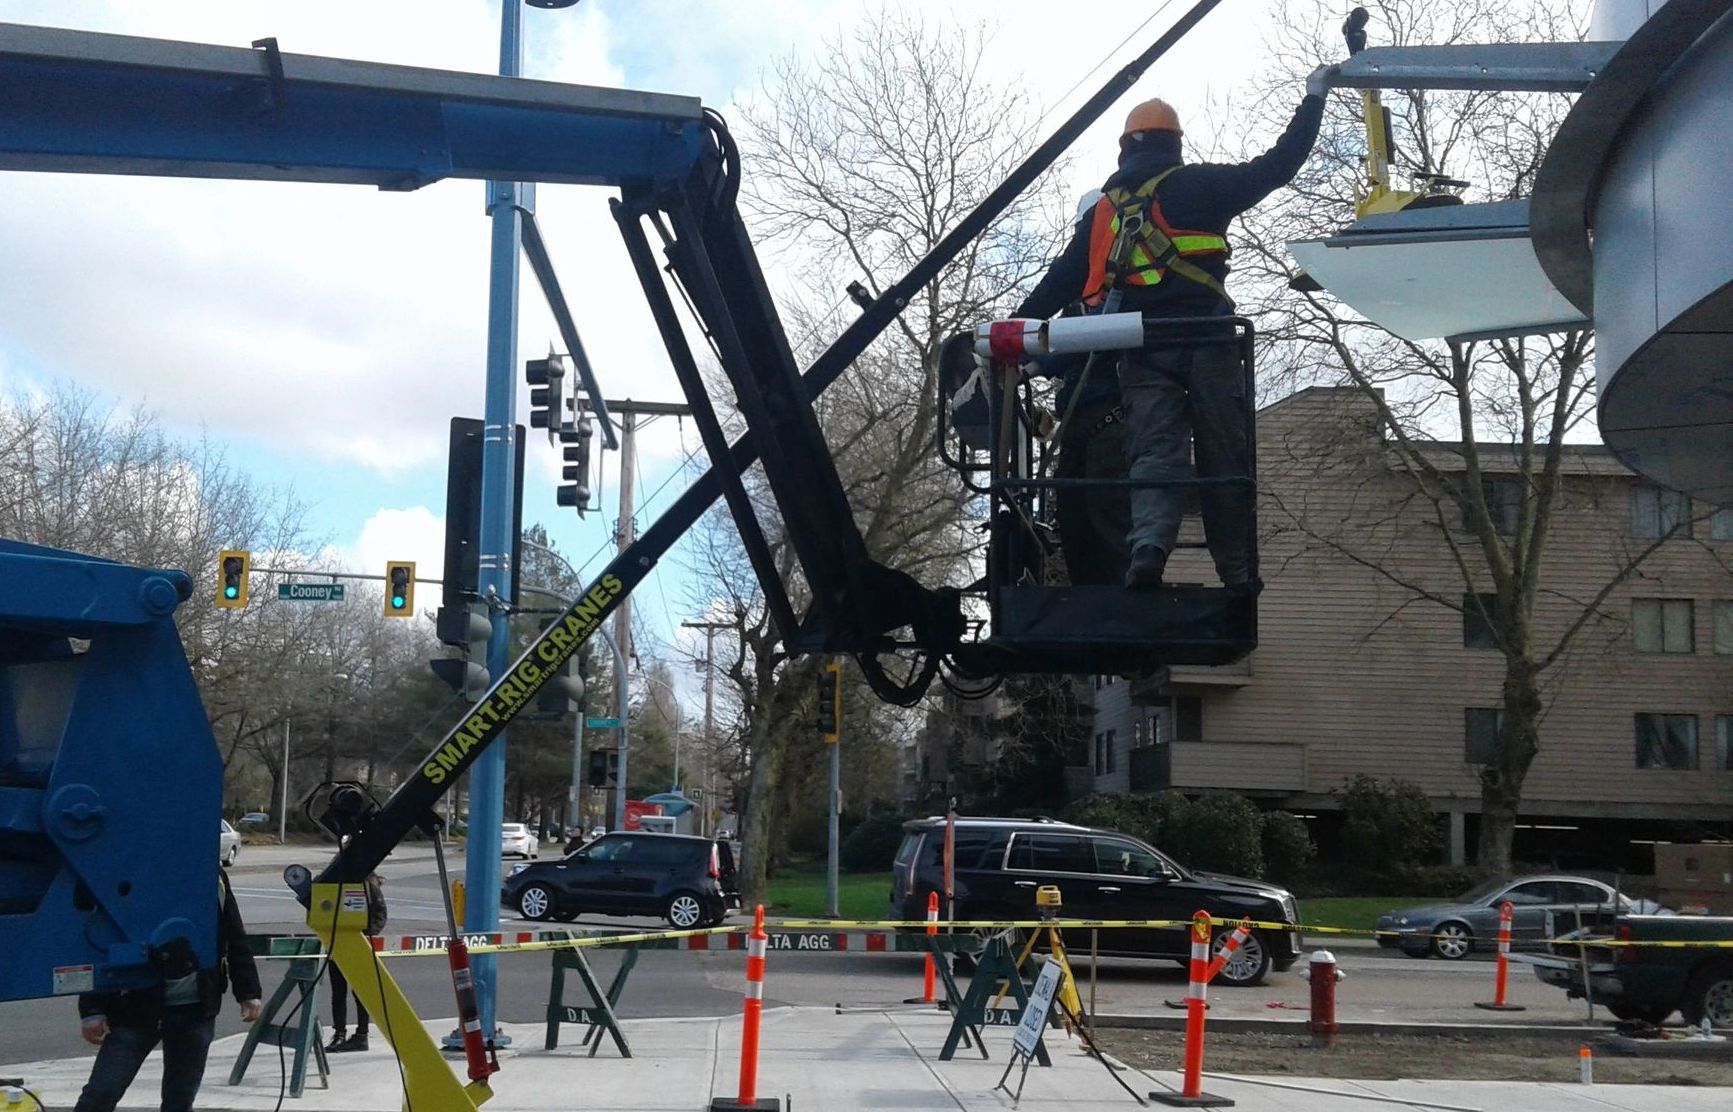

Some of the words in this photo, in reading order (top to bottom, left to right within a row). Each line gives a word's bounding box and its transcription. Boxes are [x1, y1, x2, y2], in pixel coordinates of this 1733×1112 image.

[290, 584, 332, 600] Cooney
[423, 660, 541, 785] SMART-RIG
[537, 573, 623, 664] CRANES
[501, 617, 601, 722] www.smartrigcranes.com
[415, 937, 452, 951] DELT
